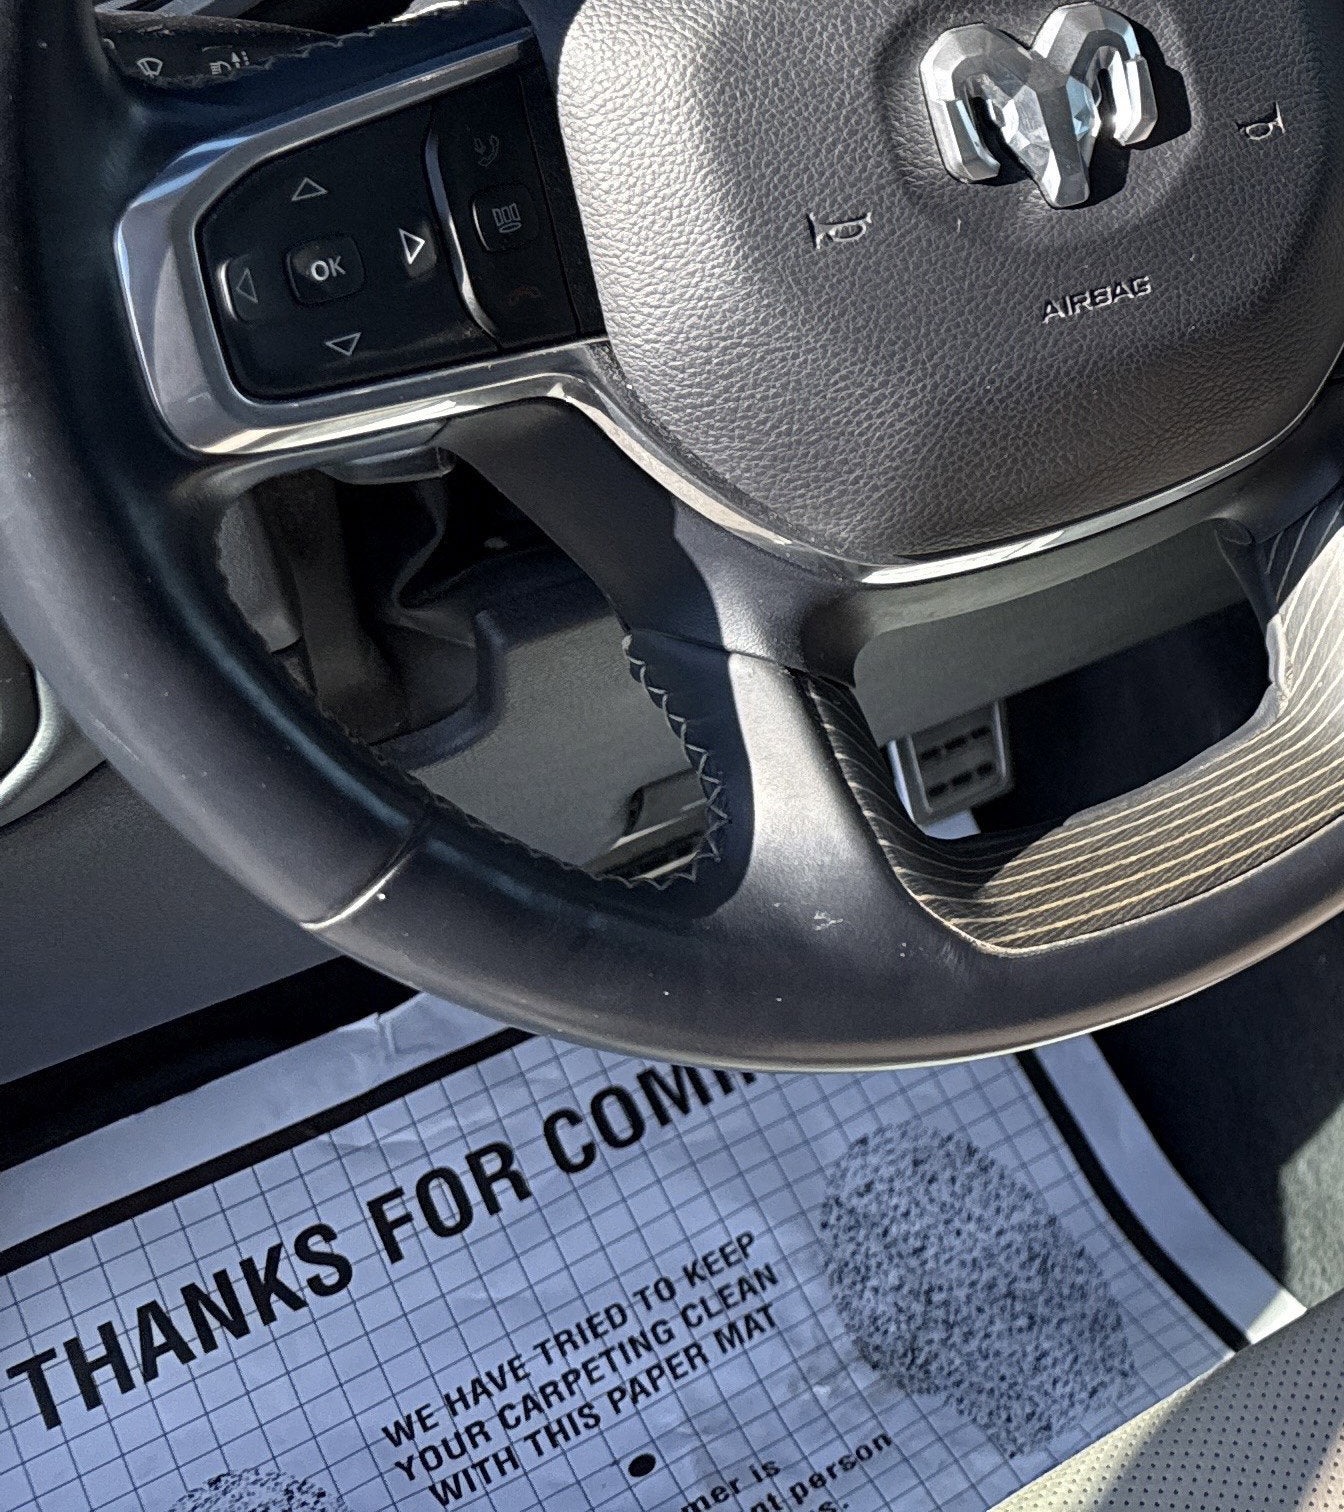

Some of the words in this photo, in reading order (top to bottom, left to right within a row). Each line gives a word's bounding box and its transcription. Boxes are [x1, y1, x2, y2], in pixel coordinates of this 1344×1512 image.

[310, 255, 347, 282] OK
[1041, 275, 1153, 325] AIRBAG
[5, 1223, 354, 1431] THANKS
[365, 1140, 533, 1265] FOR
[542, 1063, 757, 1174] COM
[381, 1403, 441, 1450] WE
[442, 1352, 532, 1418] HAVE
[532, 1301, 630, 1366] TRIED
[634, 1273, 678, 1312] TO
[683, 1229, 755, 1288] KEEP
[394, 1418, 494, 1483] YOUR
[497, 1316, 677, 1432] CARPETING
[678, 1261, 782, 1330] CLEAN
[427, 1443, 522, 1508] WITH
[523, 1399, 602, 1459] THIS
[606, 1339, 711, 1416] PAPER
[713, 1300, 781, 1355] MAT
[748, 1460, 782, 1485] is
[788, 1431, 893, 1505] person
